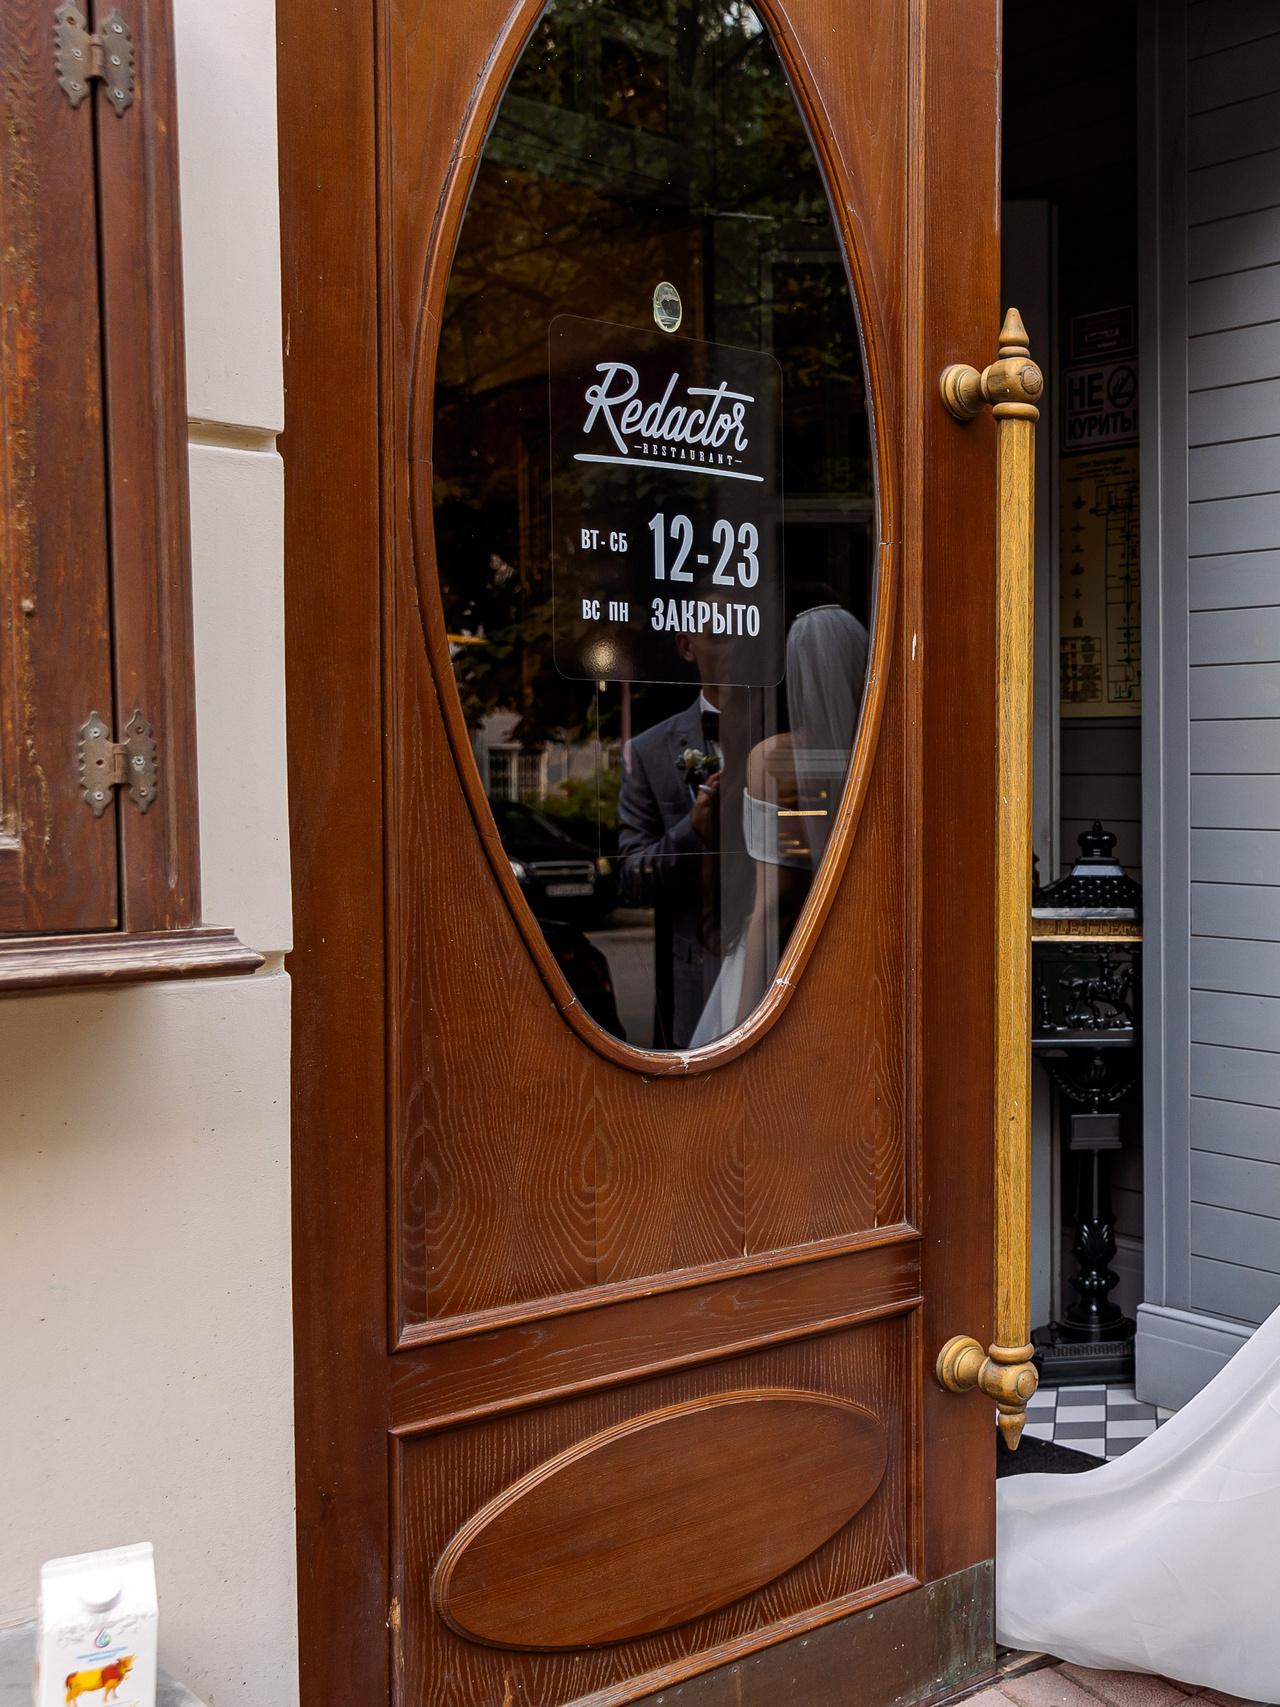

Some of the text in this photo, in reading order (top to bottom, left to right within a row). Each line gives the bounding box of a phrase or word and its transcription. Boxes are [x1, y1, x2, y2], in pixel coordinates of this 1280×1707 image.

[583, 362, 755, 454] Redactor
[1068, 372, 1104, 411] НЕ
[1068, 408, 1137, 441] КУРИТЬ!
[648, 512, 760, 588] 12-23
[582, 597, 761, 637] ВС ПН ЗАКРЫТО
